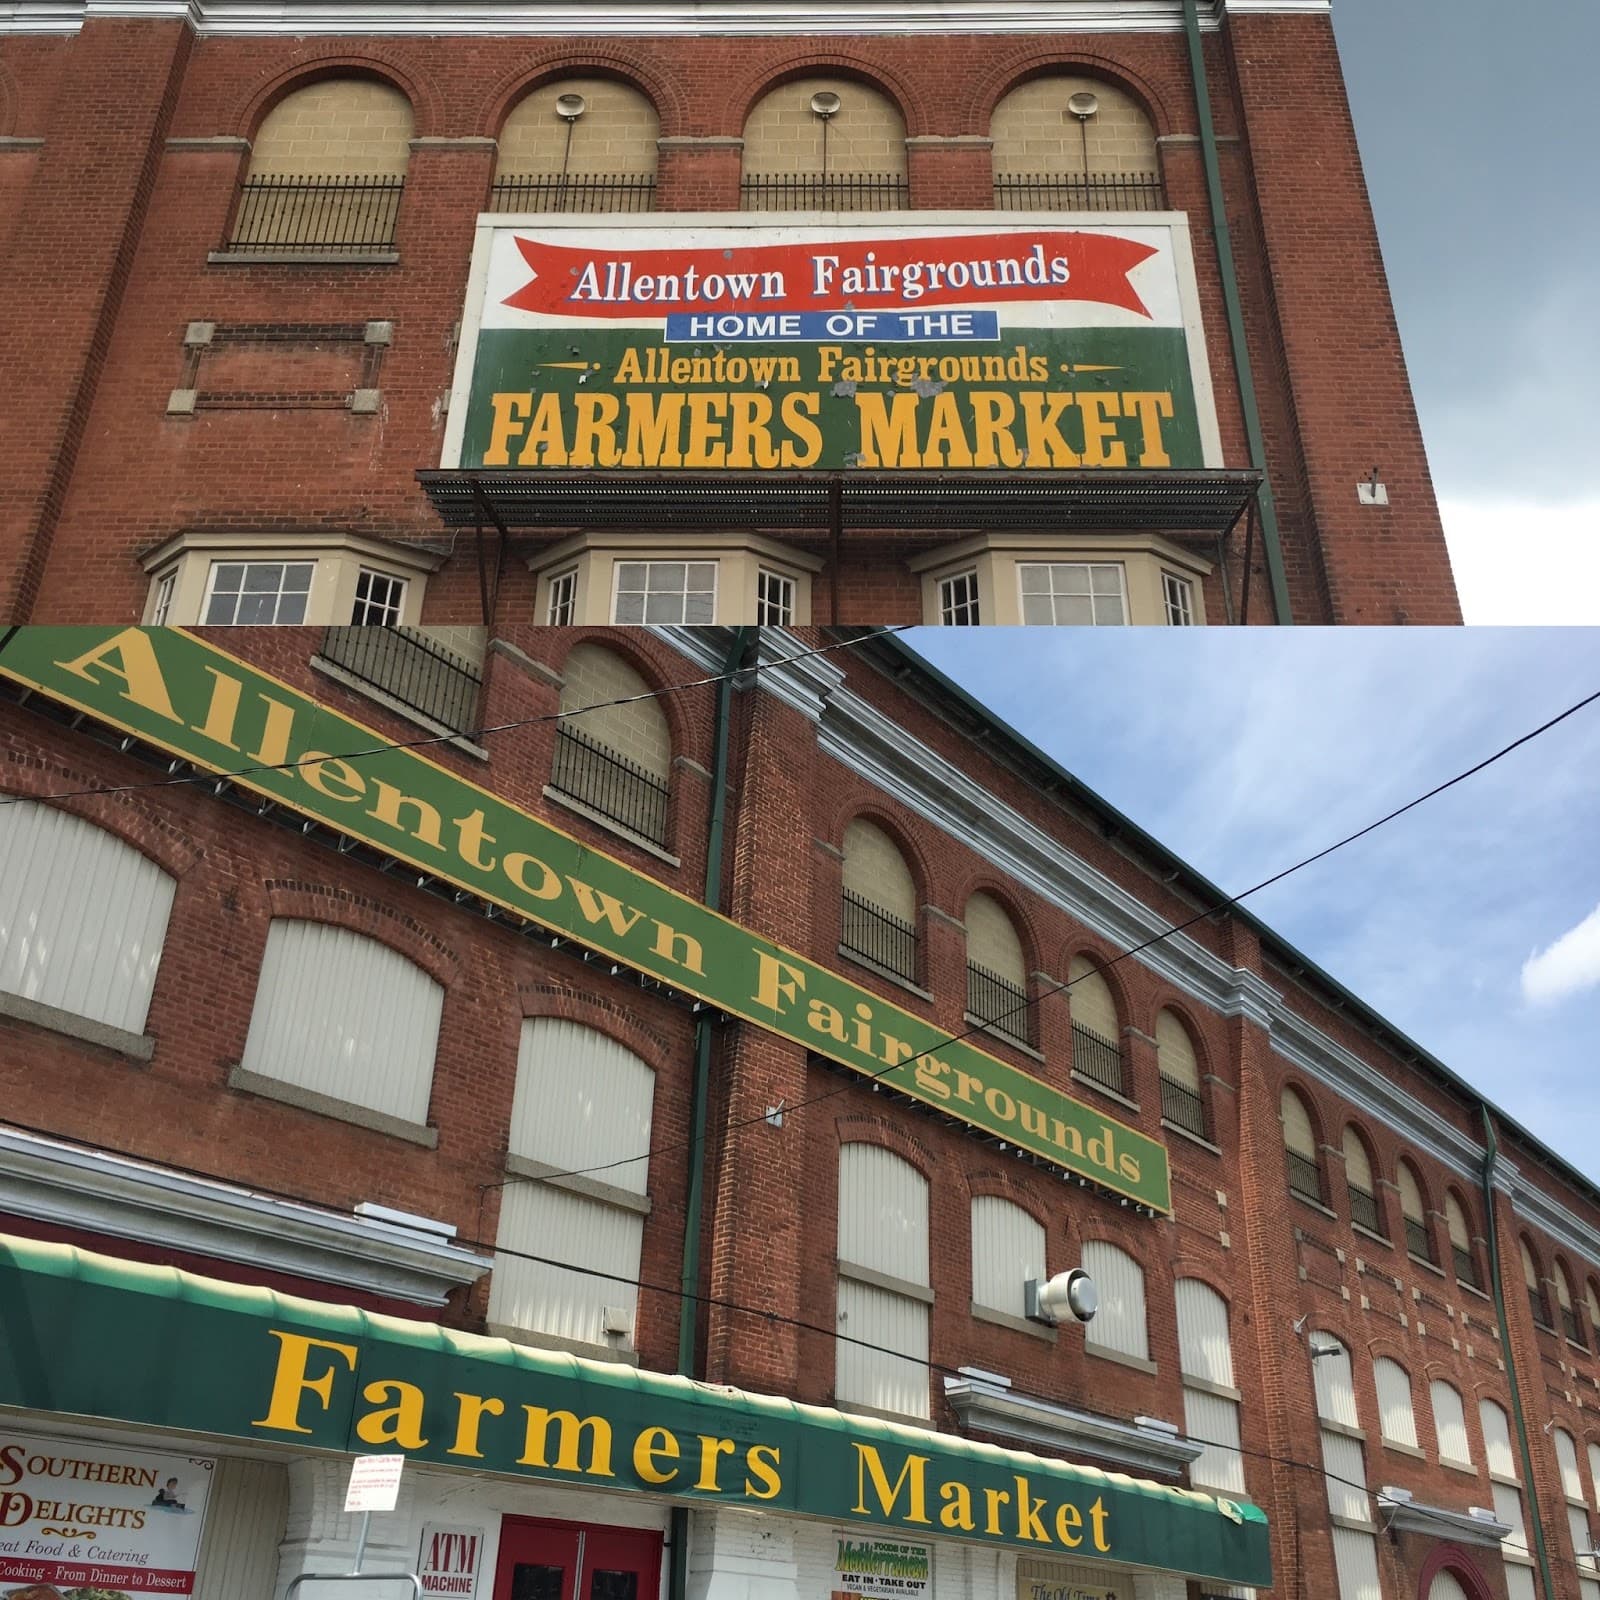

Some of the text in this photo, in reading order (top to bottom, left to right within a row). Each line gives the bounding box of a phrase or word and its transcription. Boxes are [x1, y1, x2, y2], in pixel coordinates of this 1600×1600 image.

[571, 244, 1071, 302] Allentown Fairgrounds
[690, 314, 974, 337] HOME OF THE
[613, 345, 1049, 387] Allentown Fairgrounds
[481, 390, 1174, 468] FARMERS MARKET
[54, 627, 1141, 1184] Allentown Fairgrounds
[251, 1330, 1111, 1552] Farmers Market
[0, 1445, 160, 1488] SOUTHERN
[0, 1491, 146, 1529] DELIGHTS
[25, 1540, 64, 1557] Food
[68, 1544, 81, 1558] &
[87, 1545, 149, 1565] Catering
[424, 1532, 477, 1574] ATM
[873, 1541, 927, 1556] FOODS OF THE
[0, 1561, 45, 1580] Cooking
[55, 1565, 86, 1582] From
[90, 1568, 128, 1585] Dinner
[132, 1573, 143, 1586] to
[145, 1572, 187, 1588] Dessert
[421, 1574, 473, 1593] MACHINE
[842, 1574, 860, 1583] EAT
[863, 1576, 874, 1584] IN
[877, 1578, 904, 1588] TAKE
[906, 1580, 926, 1589] OUT
